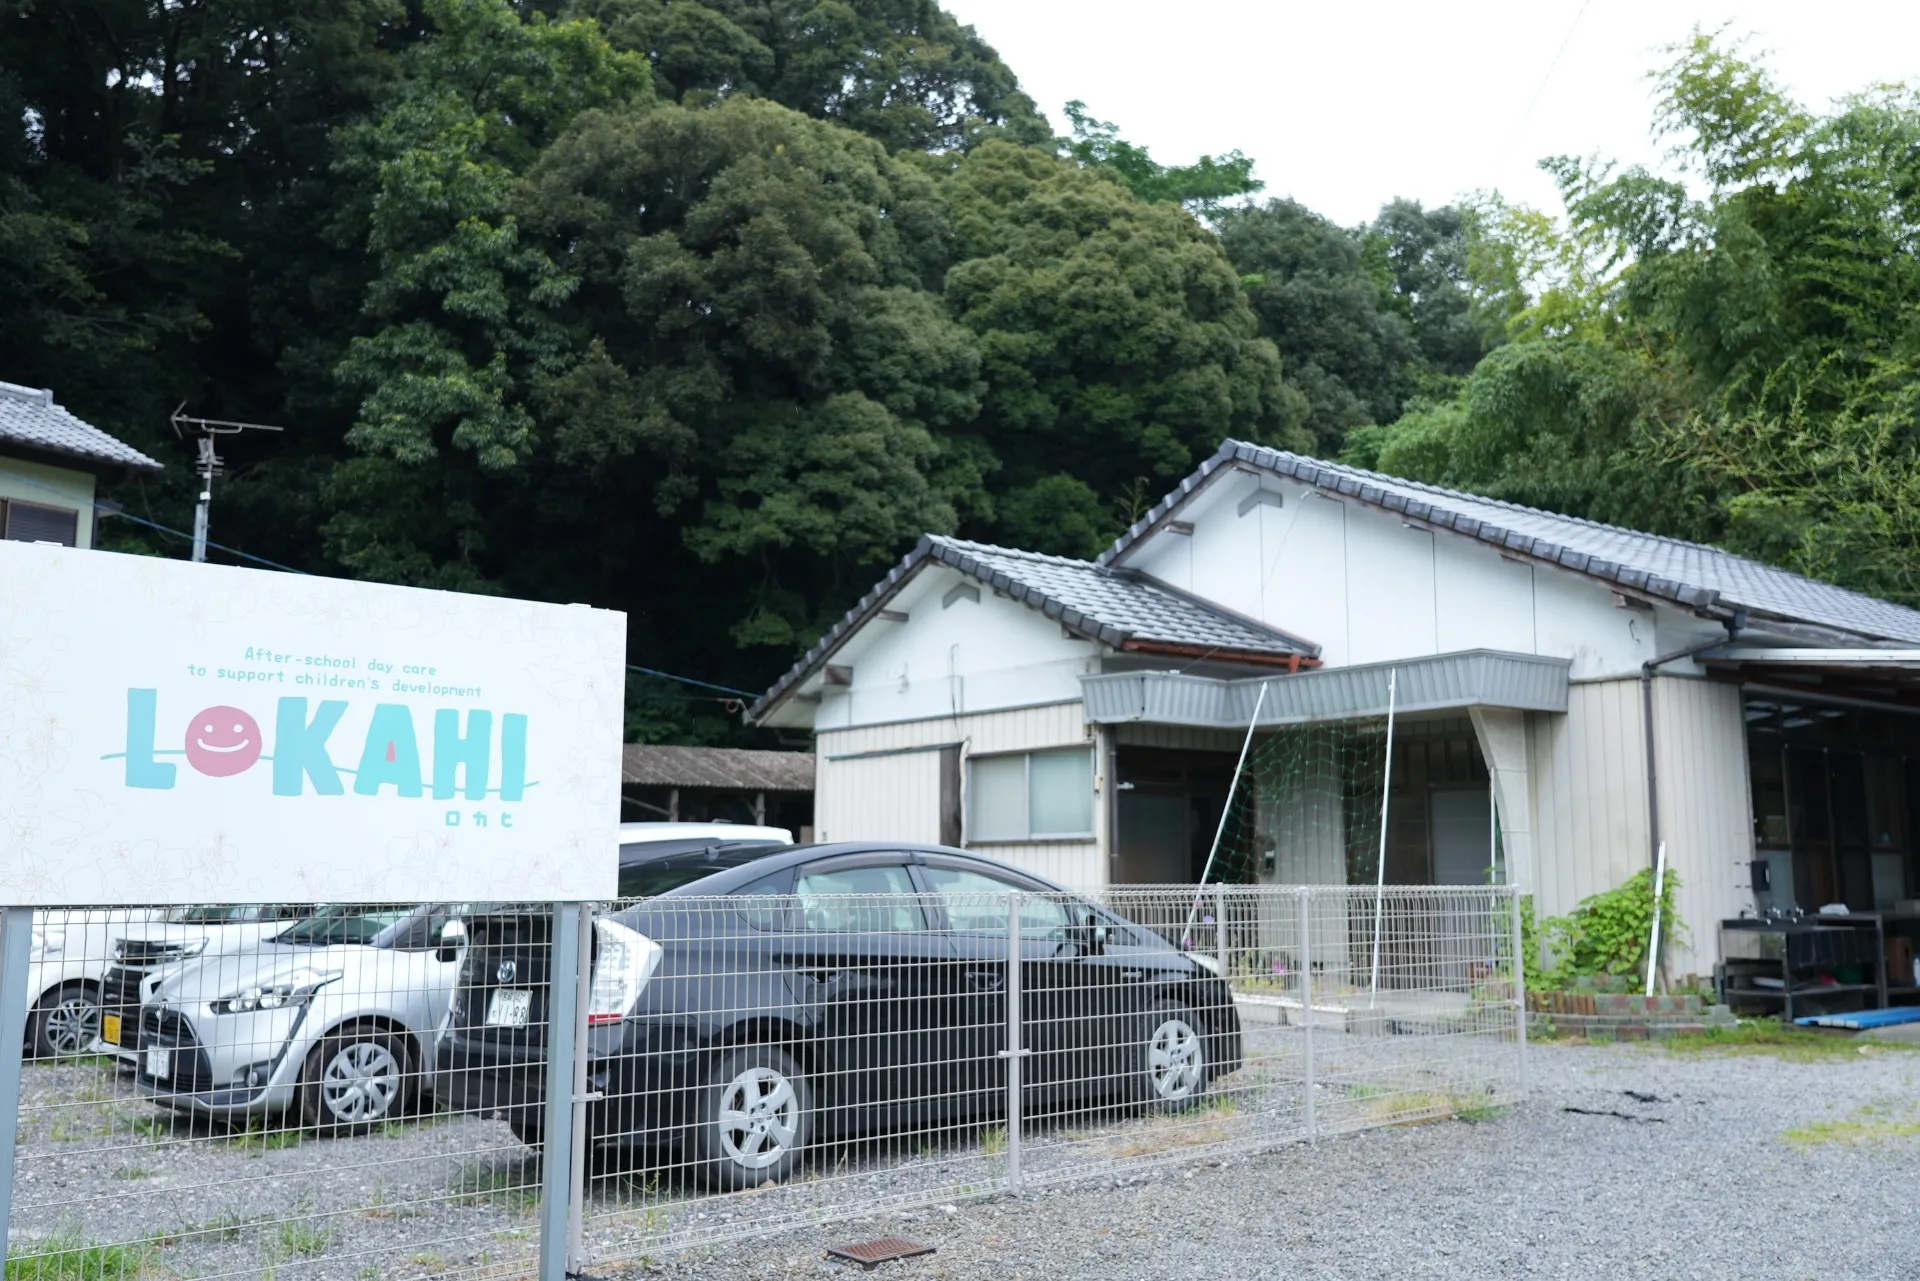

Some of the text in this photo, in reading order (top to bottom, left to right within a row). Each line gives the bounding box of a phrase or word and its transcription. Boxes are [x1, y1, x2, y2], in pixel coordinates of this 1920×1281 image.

[244, 646, 437, 676] After-school day care
[187, 663, 482, 697] to support children's development
[125, 688, 528, 802] LOKAHI
